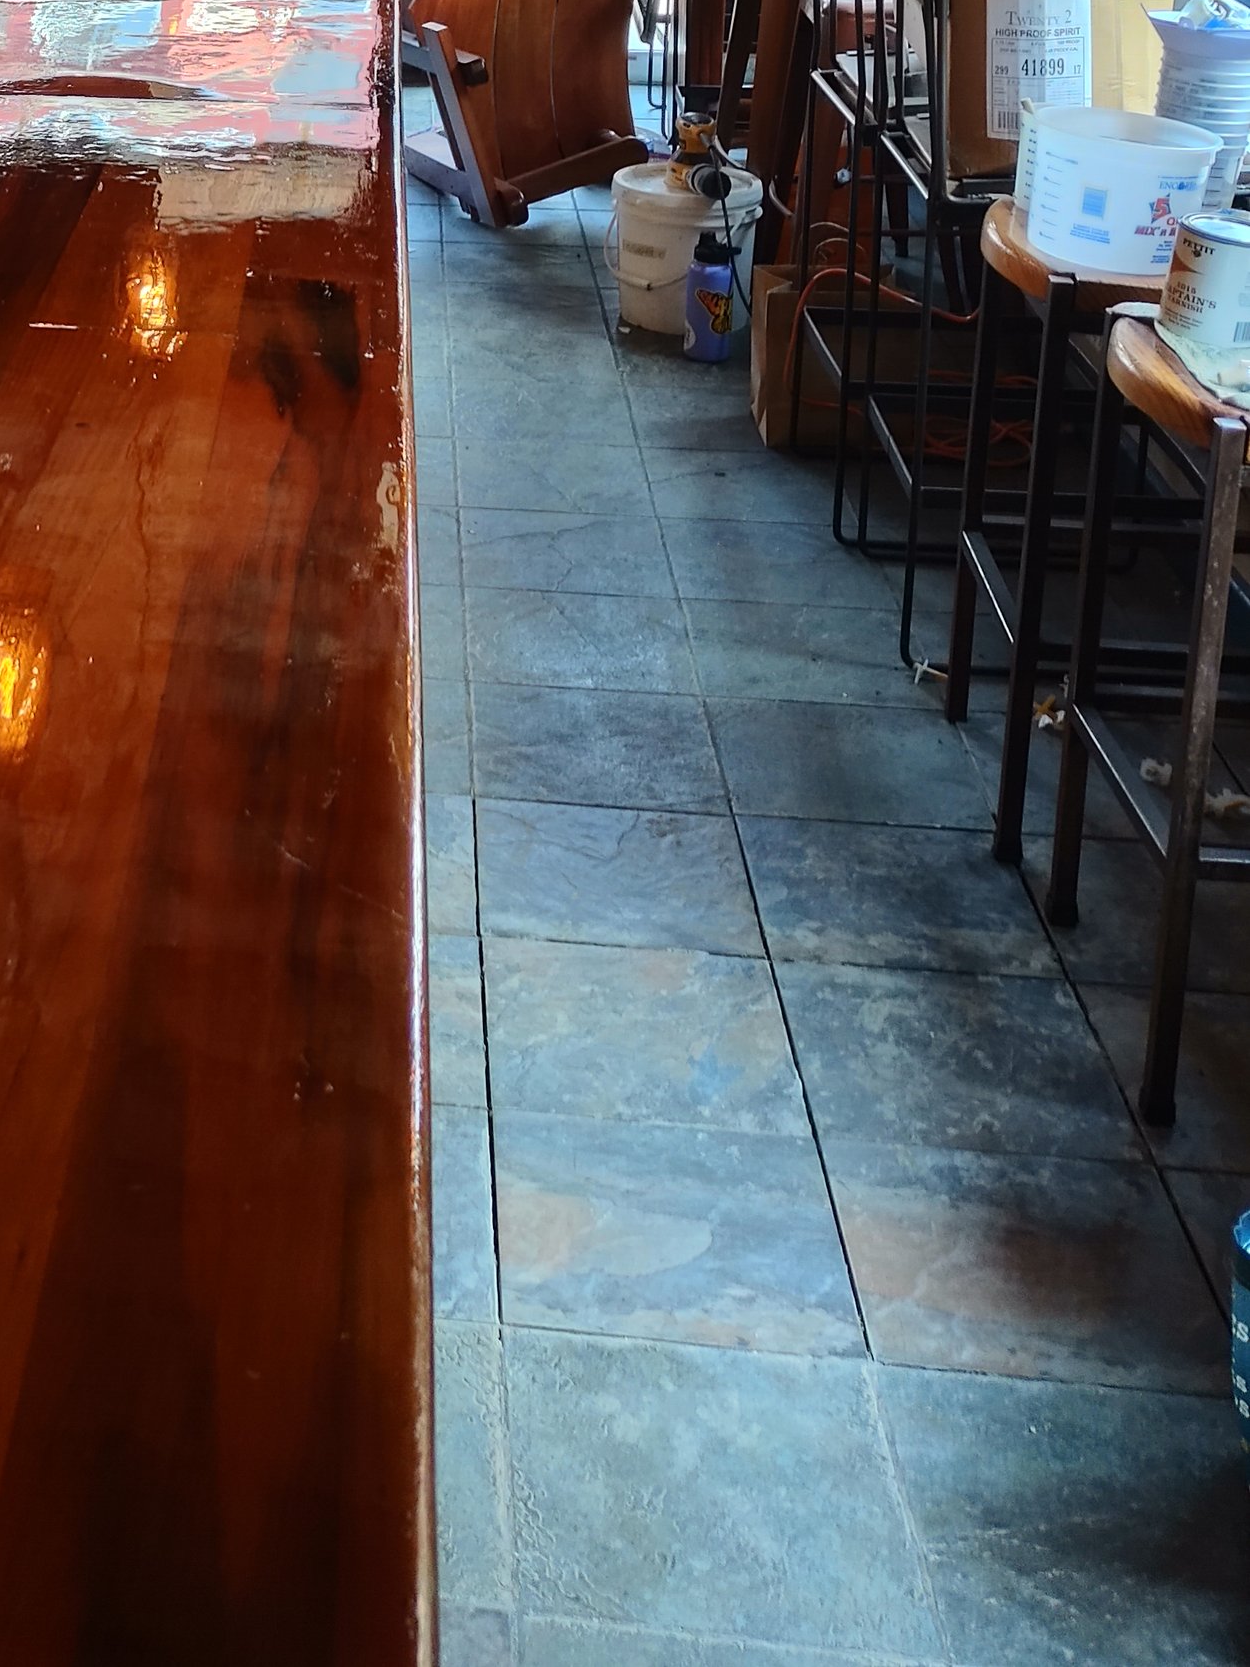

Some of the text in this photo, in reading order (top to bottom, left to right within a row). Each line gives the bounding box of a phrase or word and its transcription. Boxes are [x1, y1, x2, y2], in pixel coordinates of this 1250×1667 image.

[1005, 9, 1072, 26] TWENTY 2
[995, 26, 1081, 38] HIGH PROOF SPIRIT
[994, 57, 1082, 77] 299 41899 17
[1155, 197, 1171, 217] 5
[1182, 237, 1217, 255] PETTIT
